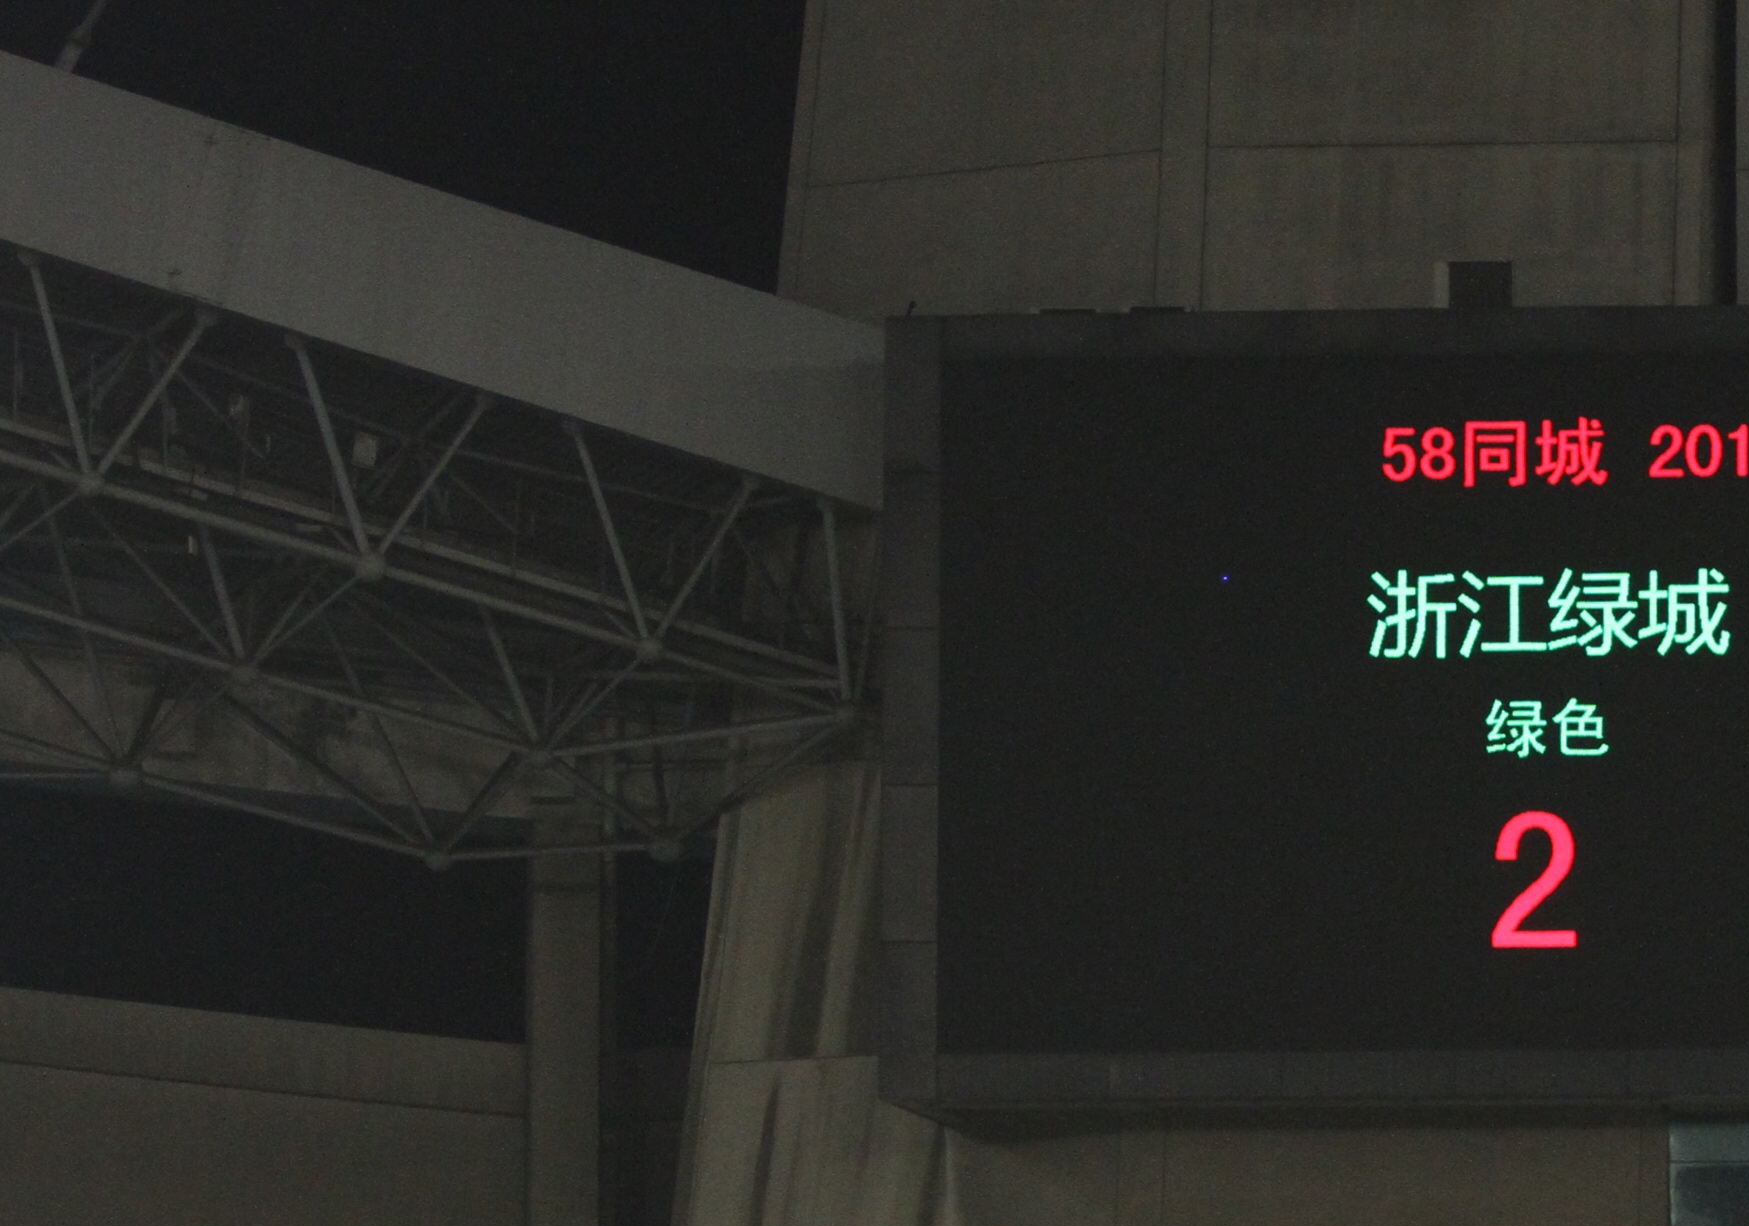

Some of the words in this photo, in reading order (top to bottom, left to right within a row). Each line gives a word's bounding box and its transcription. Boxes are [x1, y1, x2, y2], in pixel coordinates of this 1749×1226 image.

[1381, 416, 1609, 488] 58同城
[1366, 567, 1732, 660] 浙江绿城
[1485, 697, 1610, 759] 绿色
[1490, 810, 1579, 949] 2
